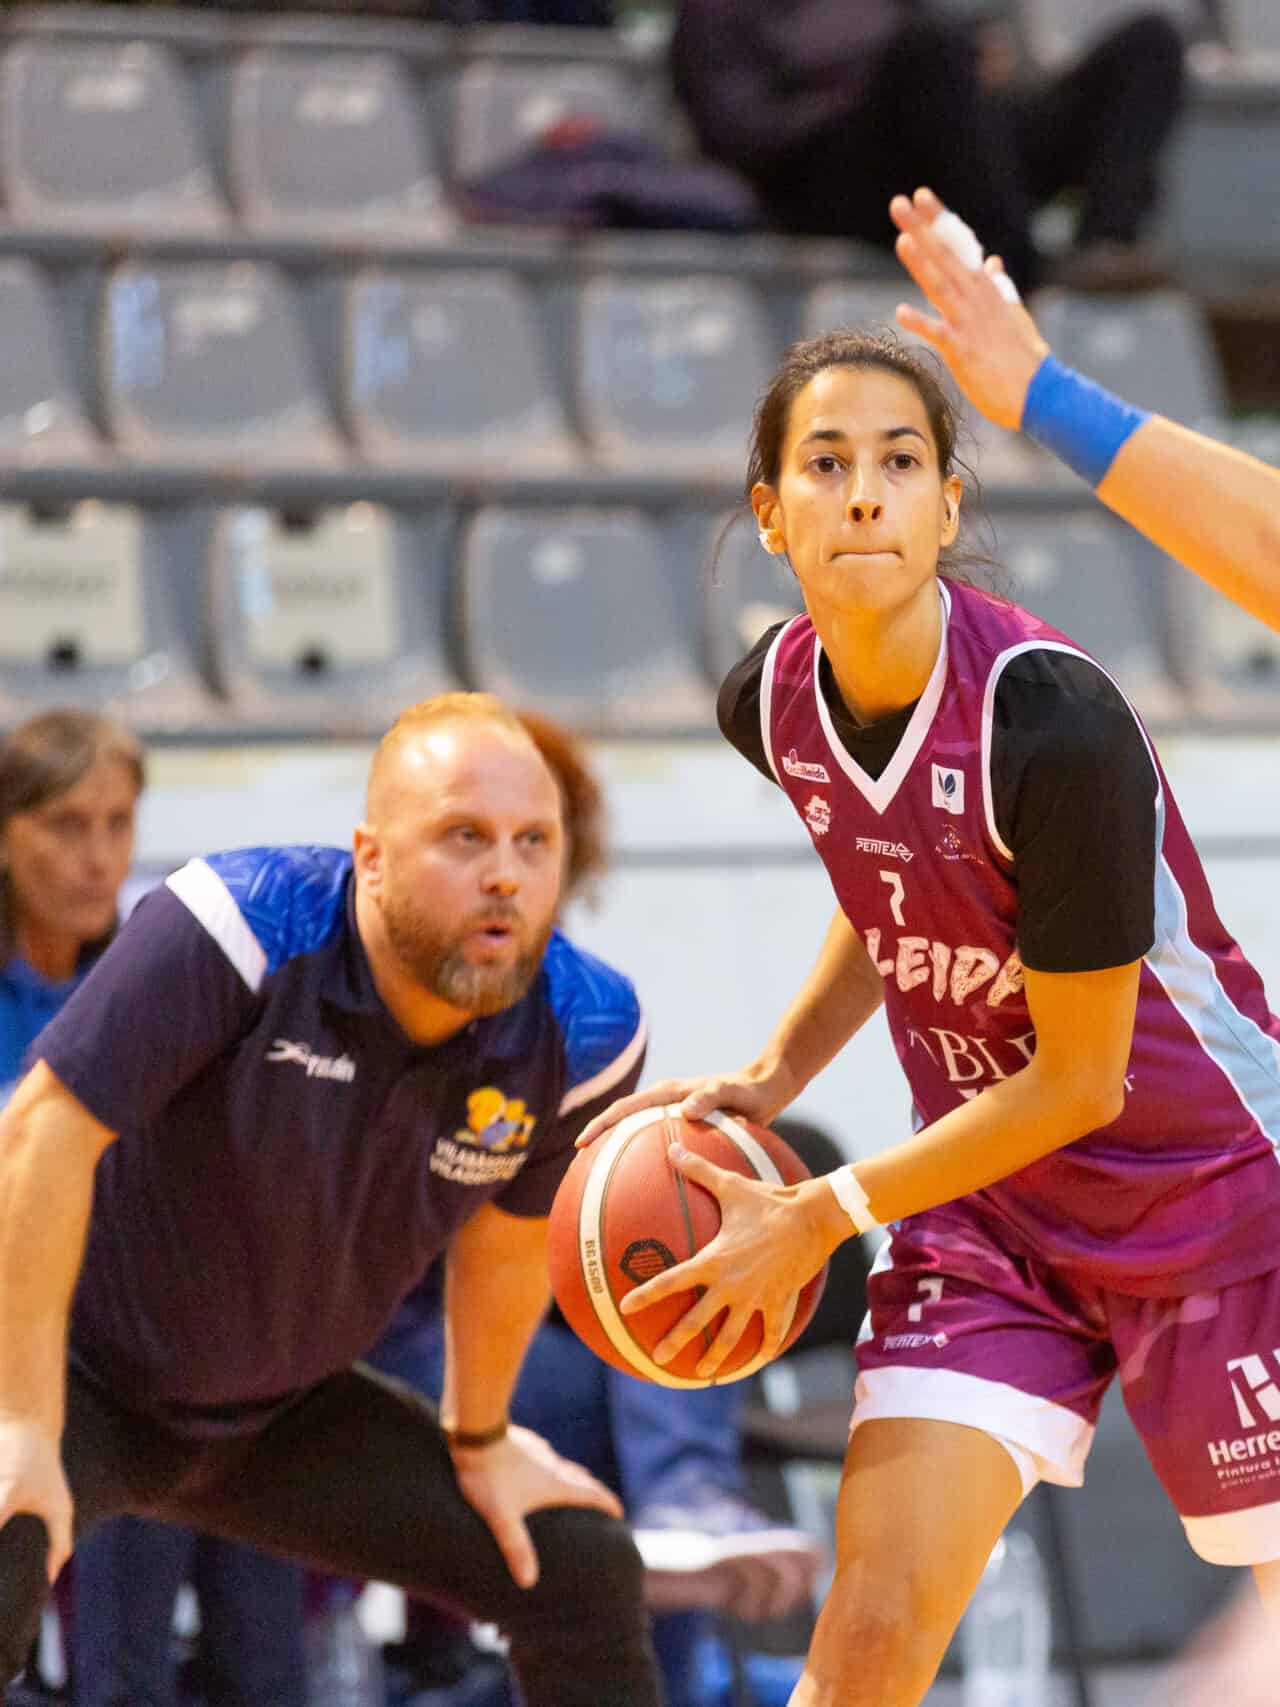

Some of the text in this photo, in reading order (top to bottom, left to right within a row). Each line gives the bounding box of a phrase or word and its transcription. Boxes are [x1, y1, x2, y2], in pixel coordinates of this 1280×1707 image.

[879, 870, 906, 926] 7
[907, 1278, 945, 1322] 7
[1217, 1460, 1272, 1480] Pintura
